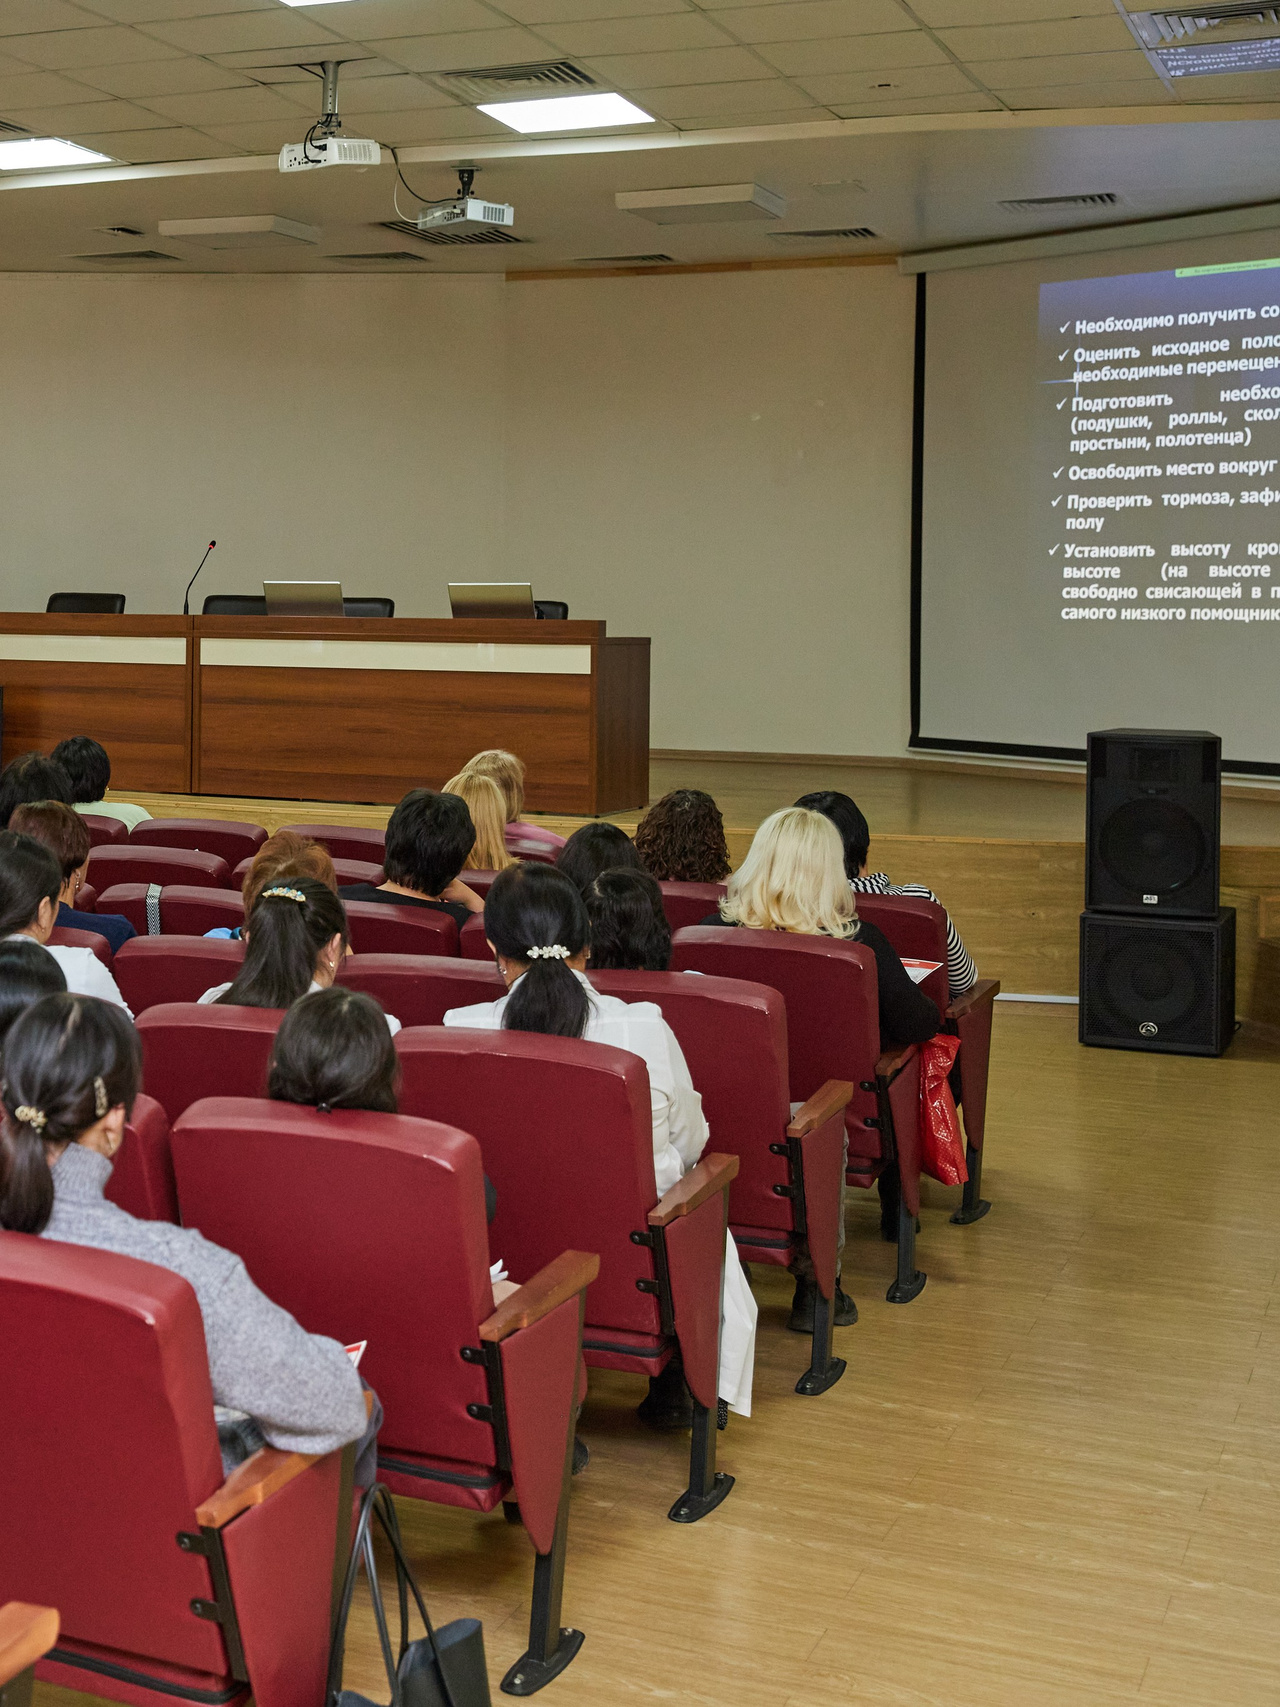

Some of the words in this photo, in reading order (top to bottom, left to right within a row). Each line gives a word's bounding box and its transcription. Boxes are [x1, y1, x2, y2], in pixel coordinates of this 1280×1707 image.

[1075, 314, 1174, 334] Необходимо
[1178, 307, 1256, 326] получить
[1261, 305, 1280, 318] со
[1074, 347, 1140, 363] Оценить
[1152, 339, 1229, 356] исходное
[1073, 363, 1182, 383] необходимые
[1072, 393, 1173, 412] Подготовить
[1072, 415, 1152, 434] (подушки,
[1170, 410, 1228, 429] роллы,
[1071, 435, 1151, 454] простыни,
[1156, 428, 1251, 448] полотенца)
[1069, 464, 1161, 480] Освободить
[1167, 462, 1214, 476] место
[1220, 460, 1277, 475] вокруг
[1067, 494, 1152, 511] Проверить
[1162, 491, 1234, 508] тормоза,
[1066, 517, 1104, 532] полу
[1064, 543, 1155, 558] Установить
[1171, 543, 1230, 559] высоту
[1248, 543, 1280, 558] кро
[1063, 566, 1120, 578] высоте
[1161, 563, 1187, 580] (на
[1209, 564, 1270, 577] высоте
[1062, 584, 1137, 600] свободно
[1146, 583, 1241, 600] свисающей
[1252, 586, 1261, 598] в
[1062, 607, 1116, 619] самого
[1121, 607, 1186, 620] низкого
